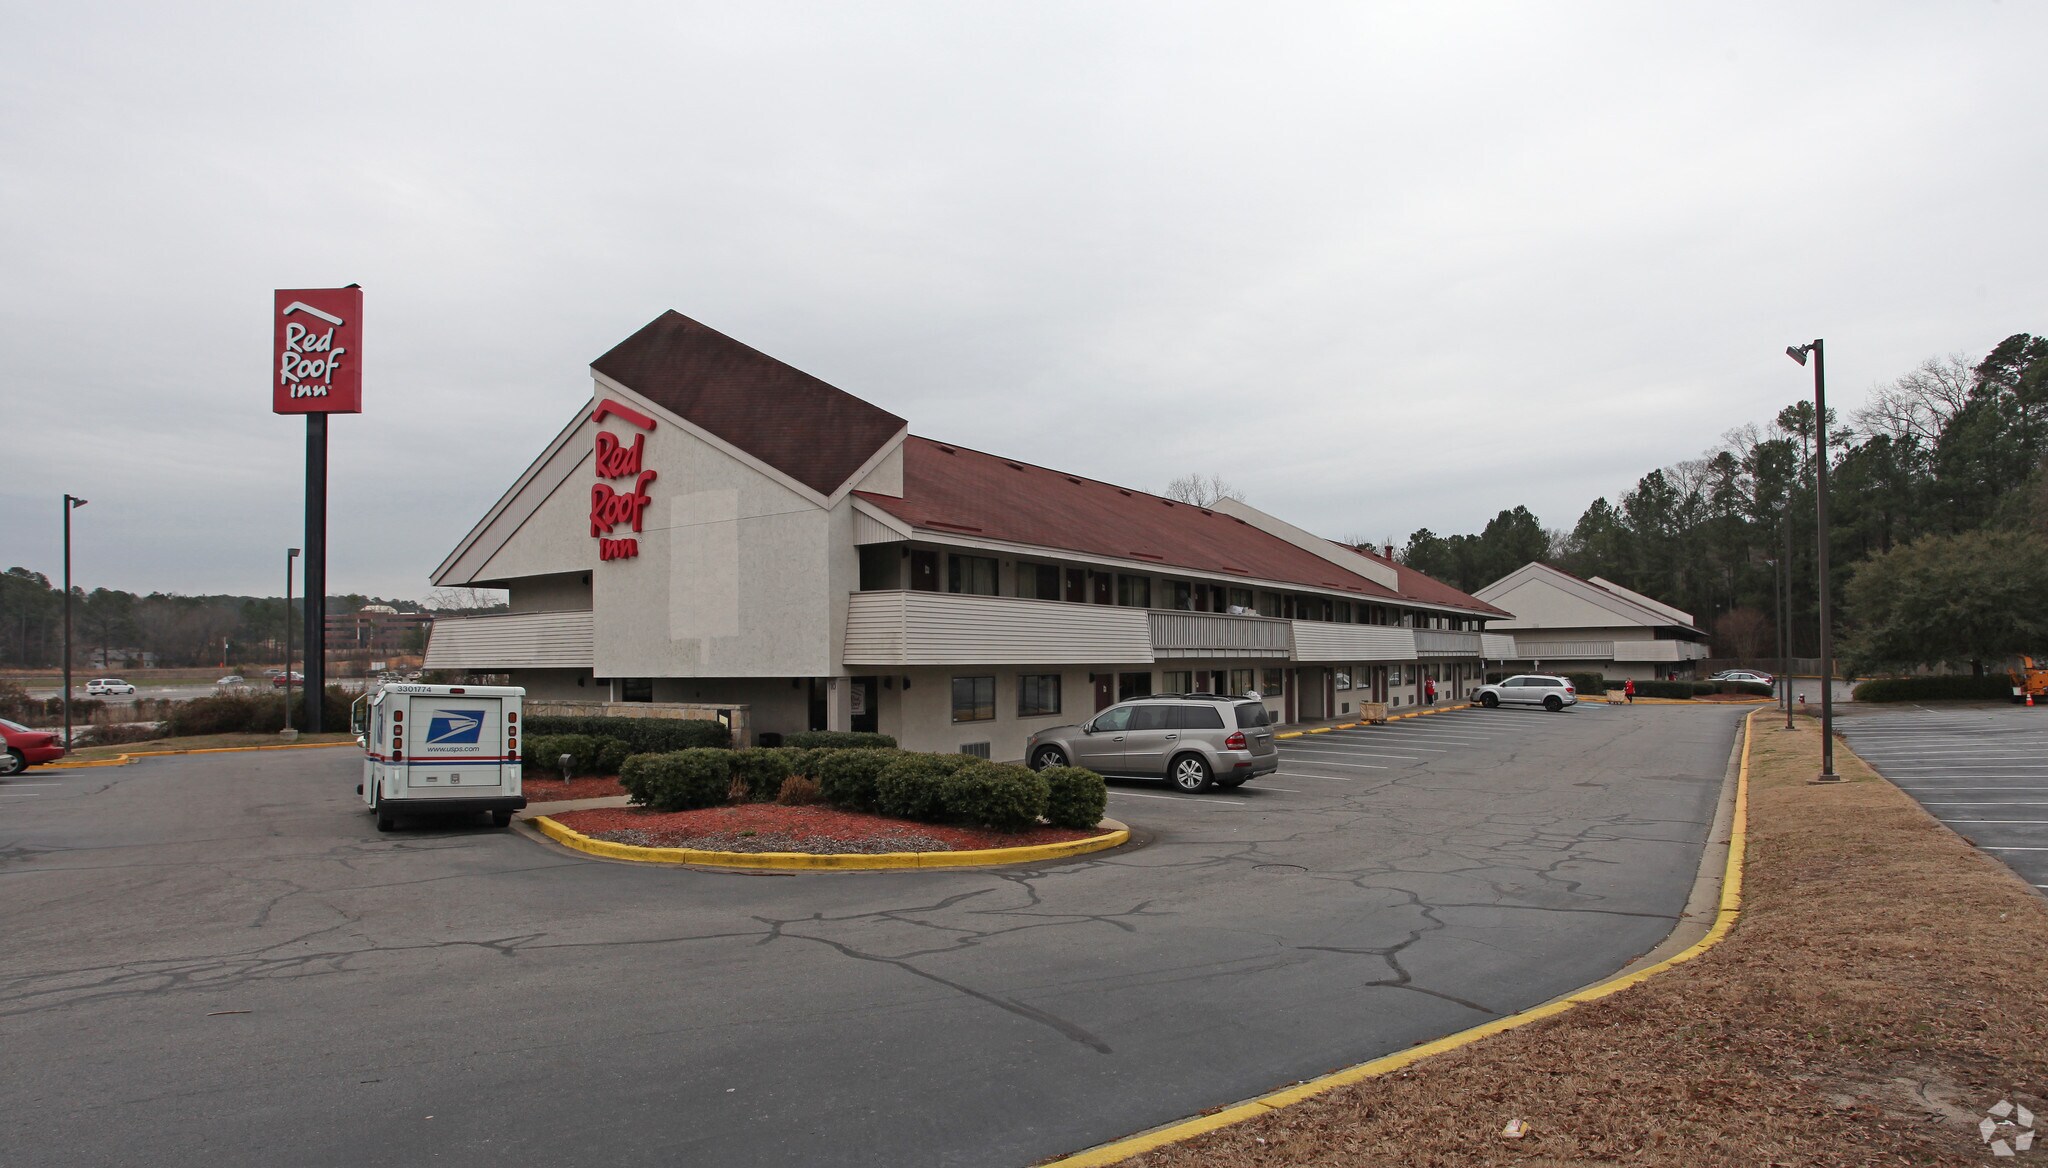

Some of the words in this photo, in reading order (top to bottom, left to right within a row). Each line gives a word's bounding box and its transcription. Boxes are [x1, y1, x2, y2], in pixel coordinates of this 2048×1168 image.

[286, 322, 334, 353] Red
[280, 347, 345, 385] Roof
[290, 383, 328, 398] Inn
[595, 431, 645, 479] Red
[590, 470, 657, 537] Roof
[600, 538, 638, 561] Inn
[397, 685, 432, 693] 3301774
